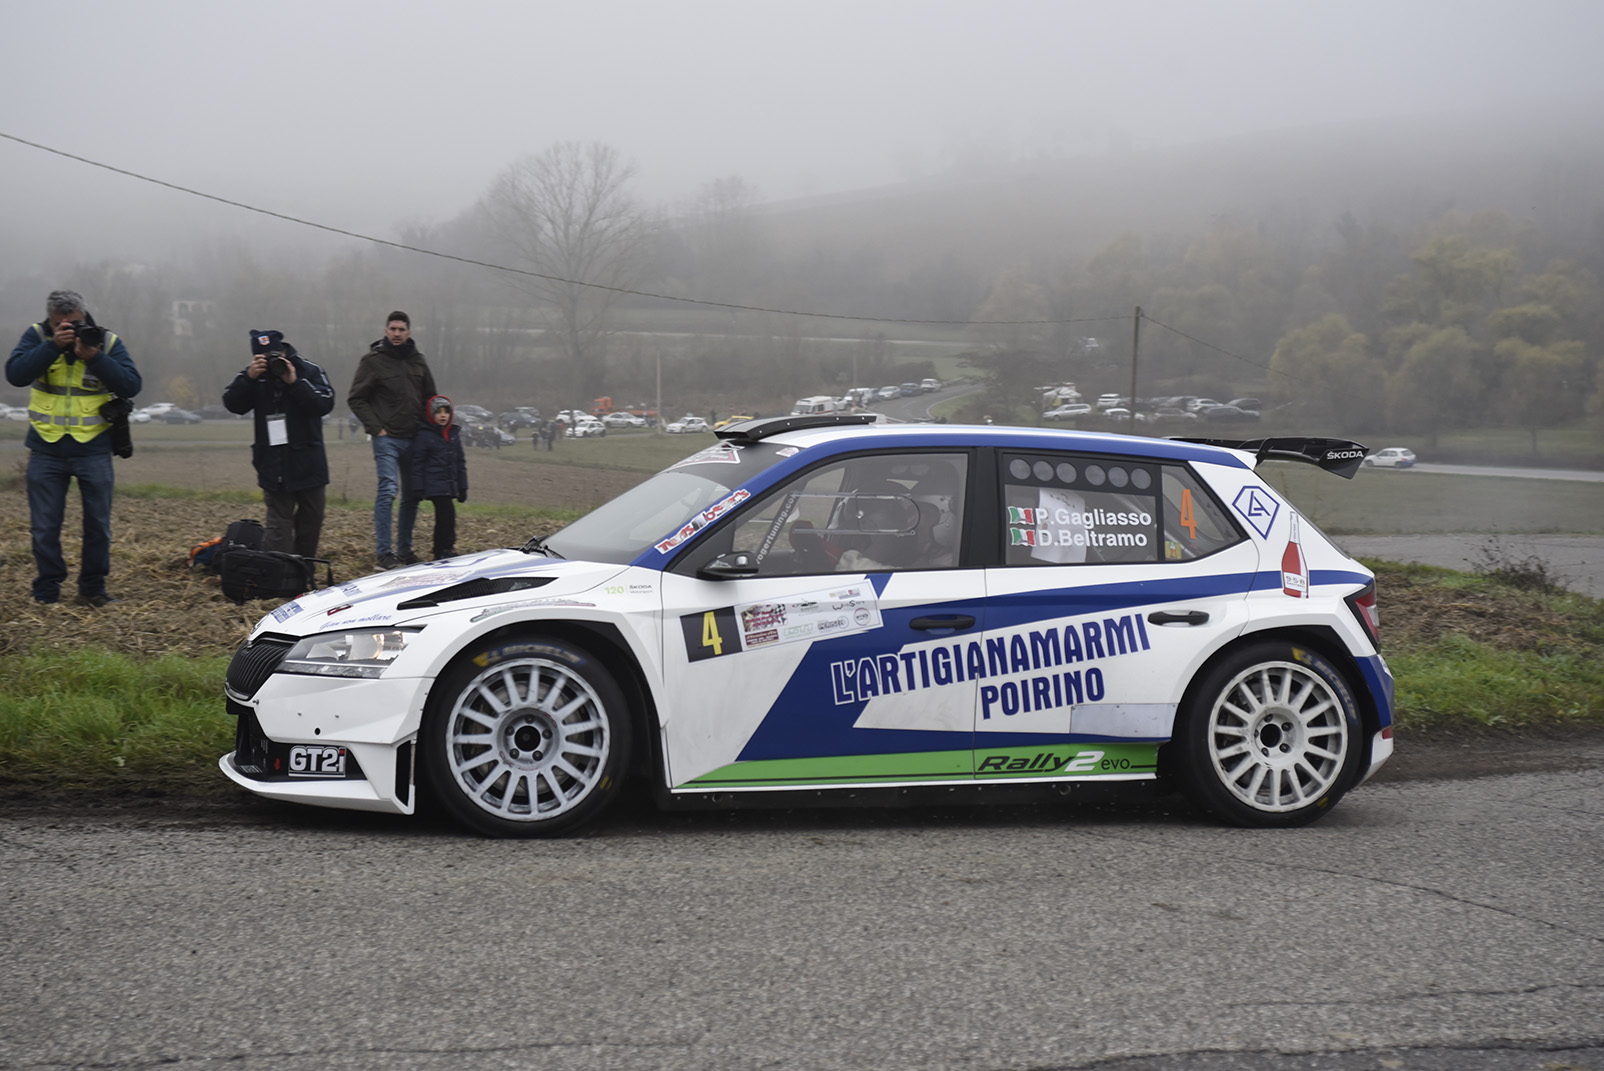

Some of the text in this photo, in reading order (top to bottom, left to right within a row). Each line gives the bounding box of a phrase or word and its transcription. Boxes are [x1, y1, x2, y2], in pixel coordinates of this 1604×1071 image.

[1327, 450, 1365, 460] ŠKODA
[1035, 507, 1152, 529] P.Gagliasso
[1180, 488, 1198, 540] 4
[1039, 529, 1148, 547] D.Beltramo
[604, 586, 625, 595] 120
[358, 613, 392, 623] mollare
[701, 611, 723, 656] 4
[830, 612, 1152, 706] L'ARTIGIANAMARMI
[979, 667, 1106, 721] POIRINO
[1101, 757, 1131, 770] evo
